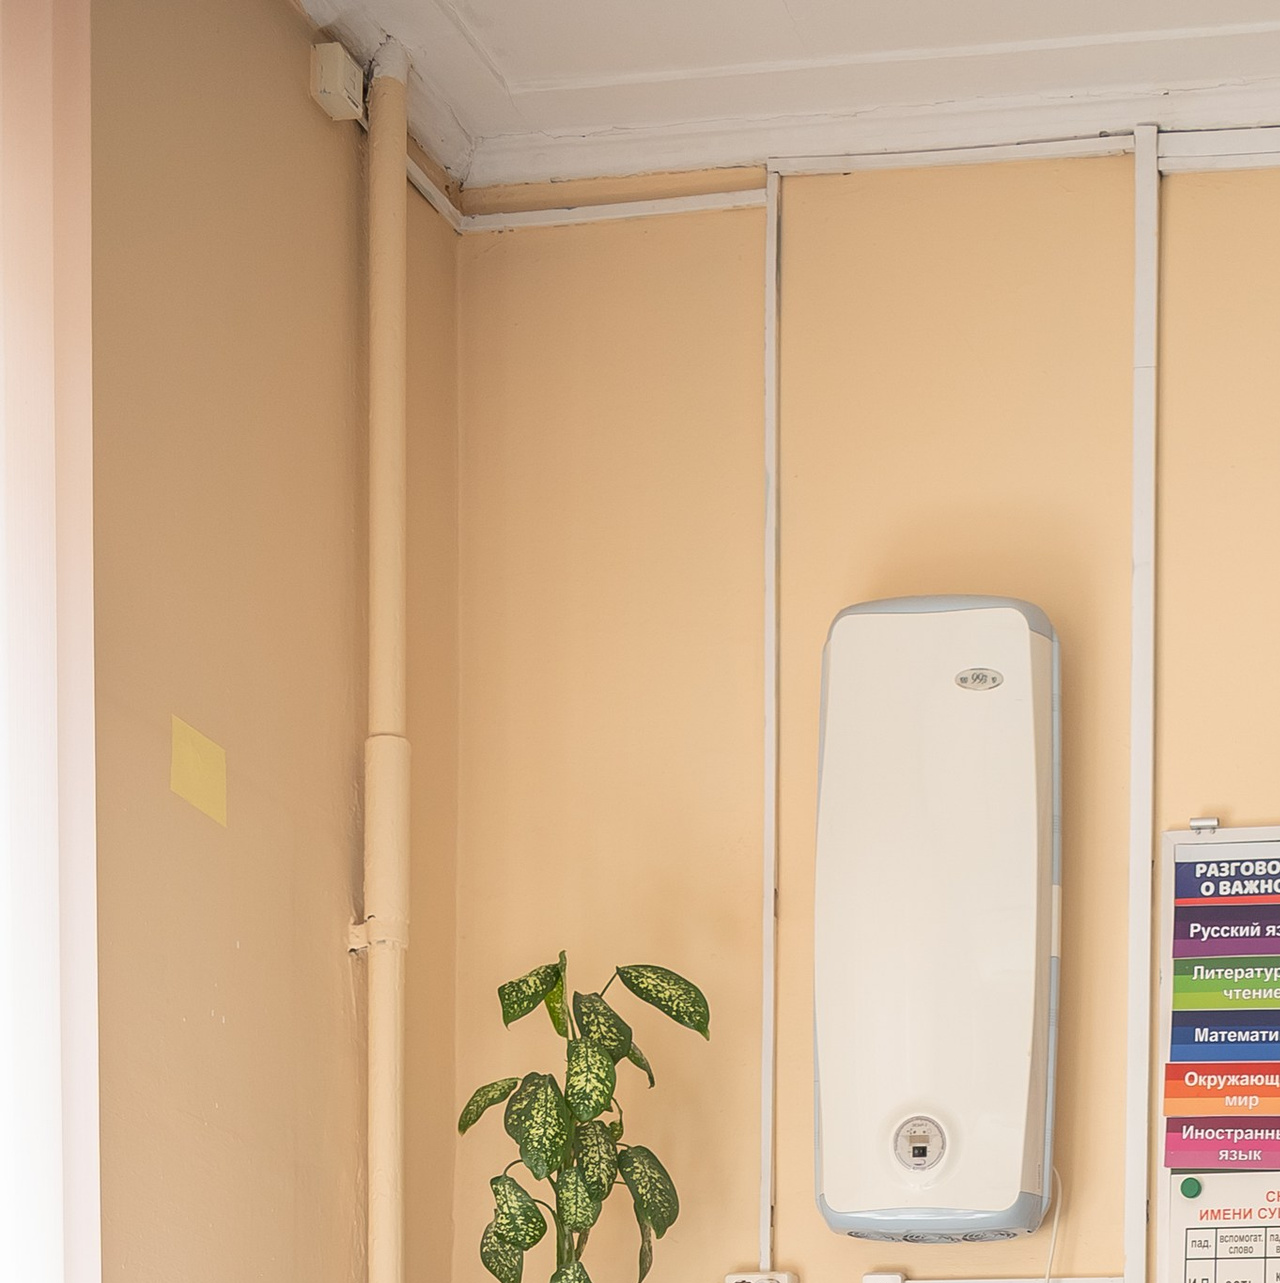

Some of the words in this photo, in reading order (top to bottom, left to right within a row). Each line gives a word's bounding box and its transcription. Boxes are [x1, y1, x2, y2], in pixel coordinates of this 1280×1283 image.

[1201, 882, 1215, 896] О
[1190, 923, 1261, 941] Русский
[1225, 1096, 1259, 1109] мир
[1219, 1150, 1262, 1160] язык
[1199, 1208, 1252, 1220] ИМЕНИ
[1191, 1238, 1212, 1250] пад.
[1219, 1233, 1263, 1243] вспомогат.
[1228, 1245, 1254, 1254] слово
